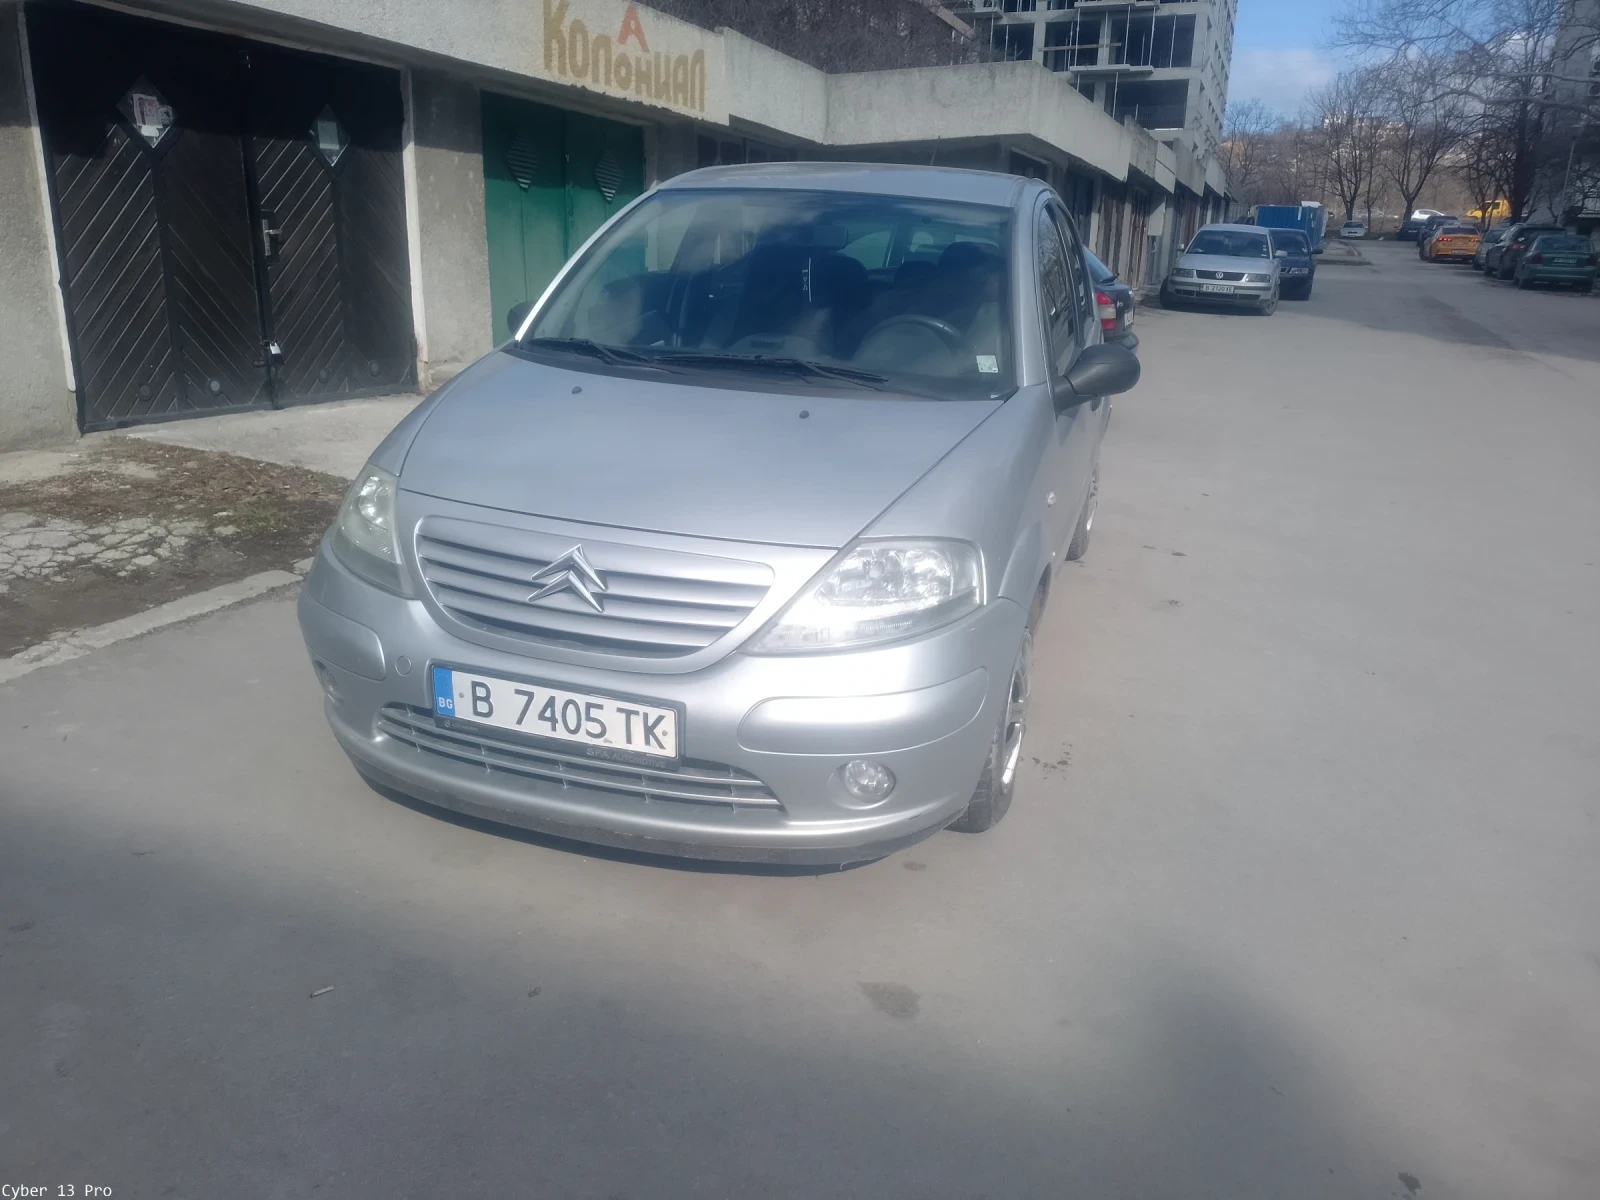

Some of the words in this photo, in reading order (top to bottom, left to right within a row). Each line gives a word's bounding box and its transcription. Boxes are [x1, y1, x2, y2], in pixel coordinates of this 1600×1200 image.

[438, 697, 454, 709] BG
[471, 680, 494, 718] B
[514, 688, 607, 739] 7405
[616, 706, 667, 750] TK
[612, 753, 667, 768] AUTOMOTIVE
